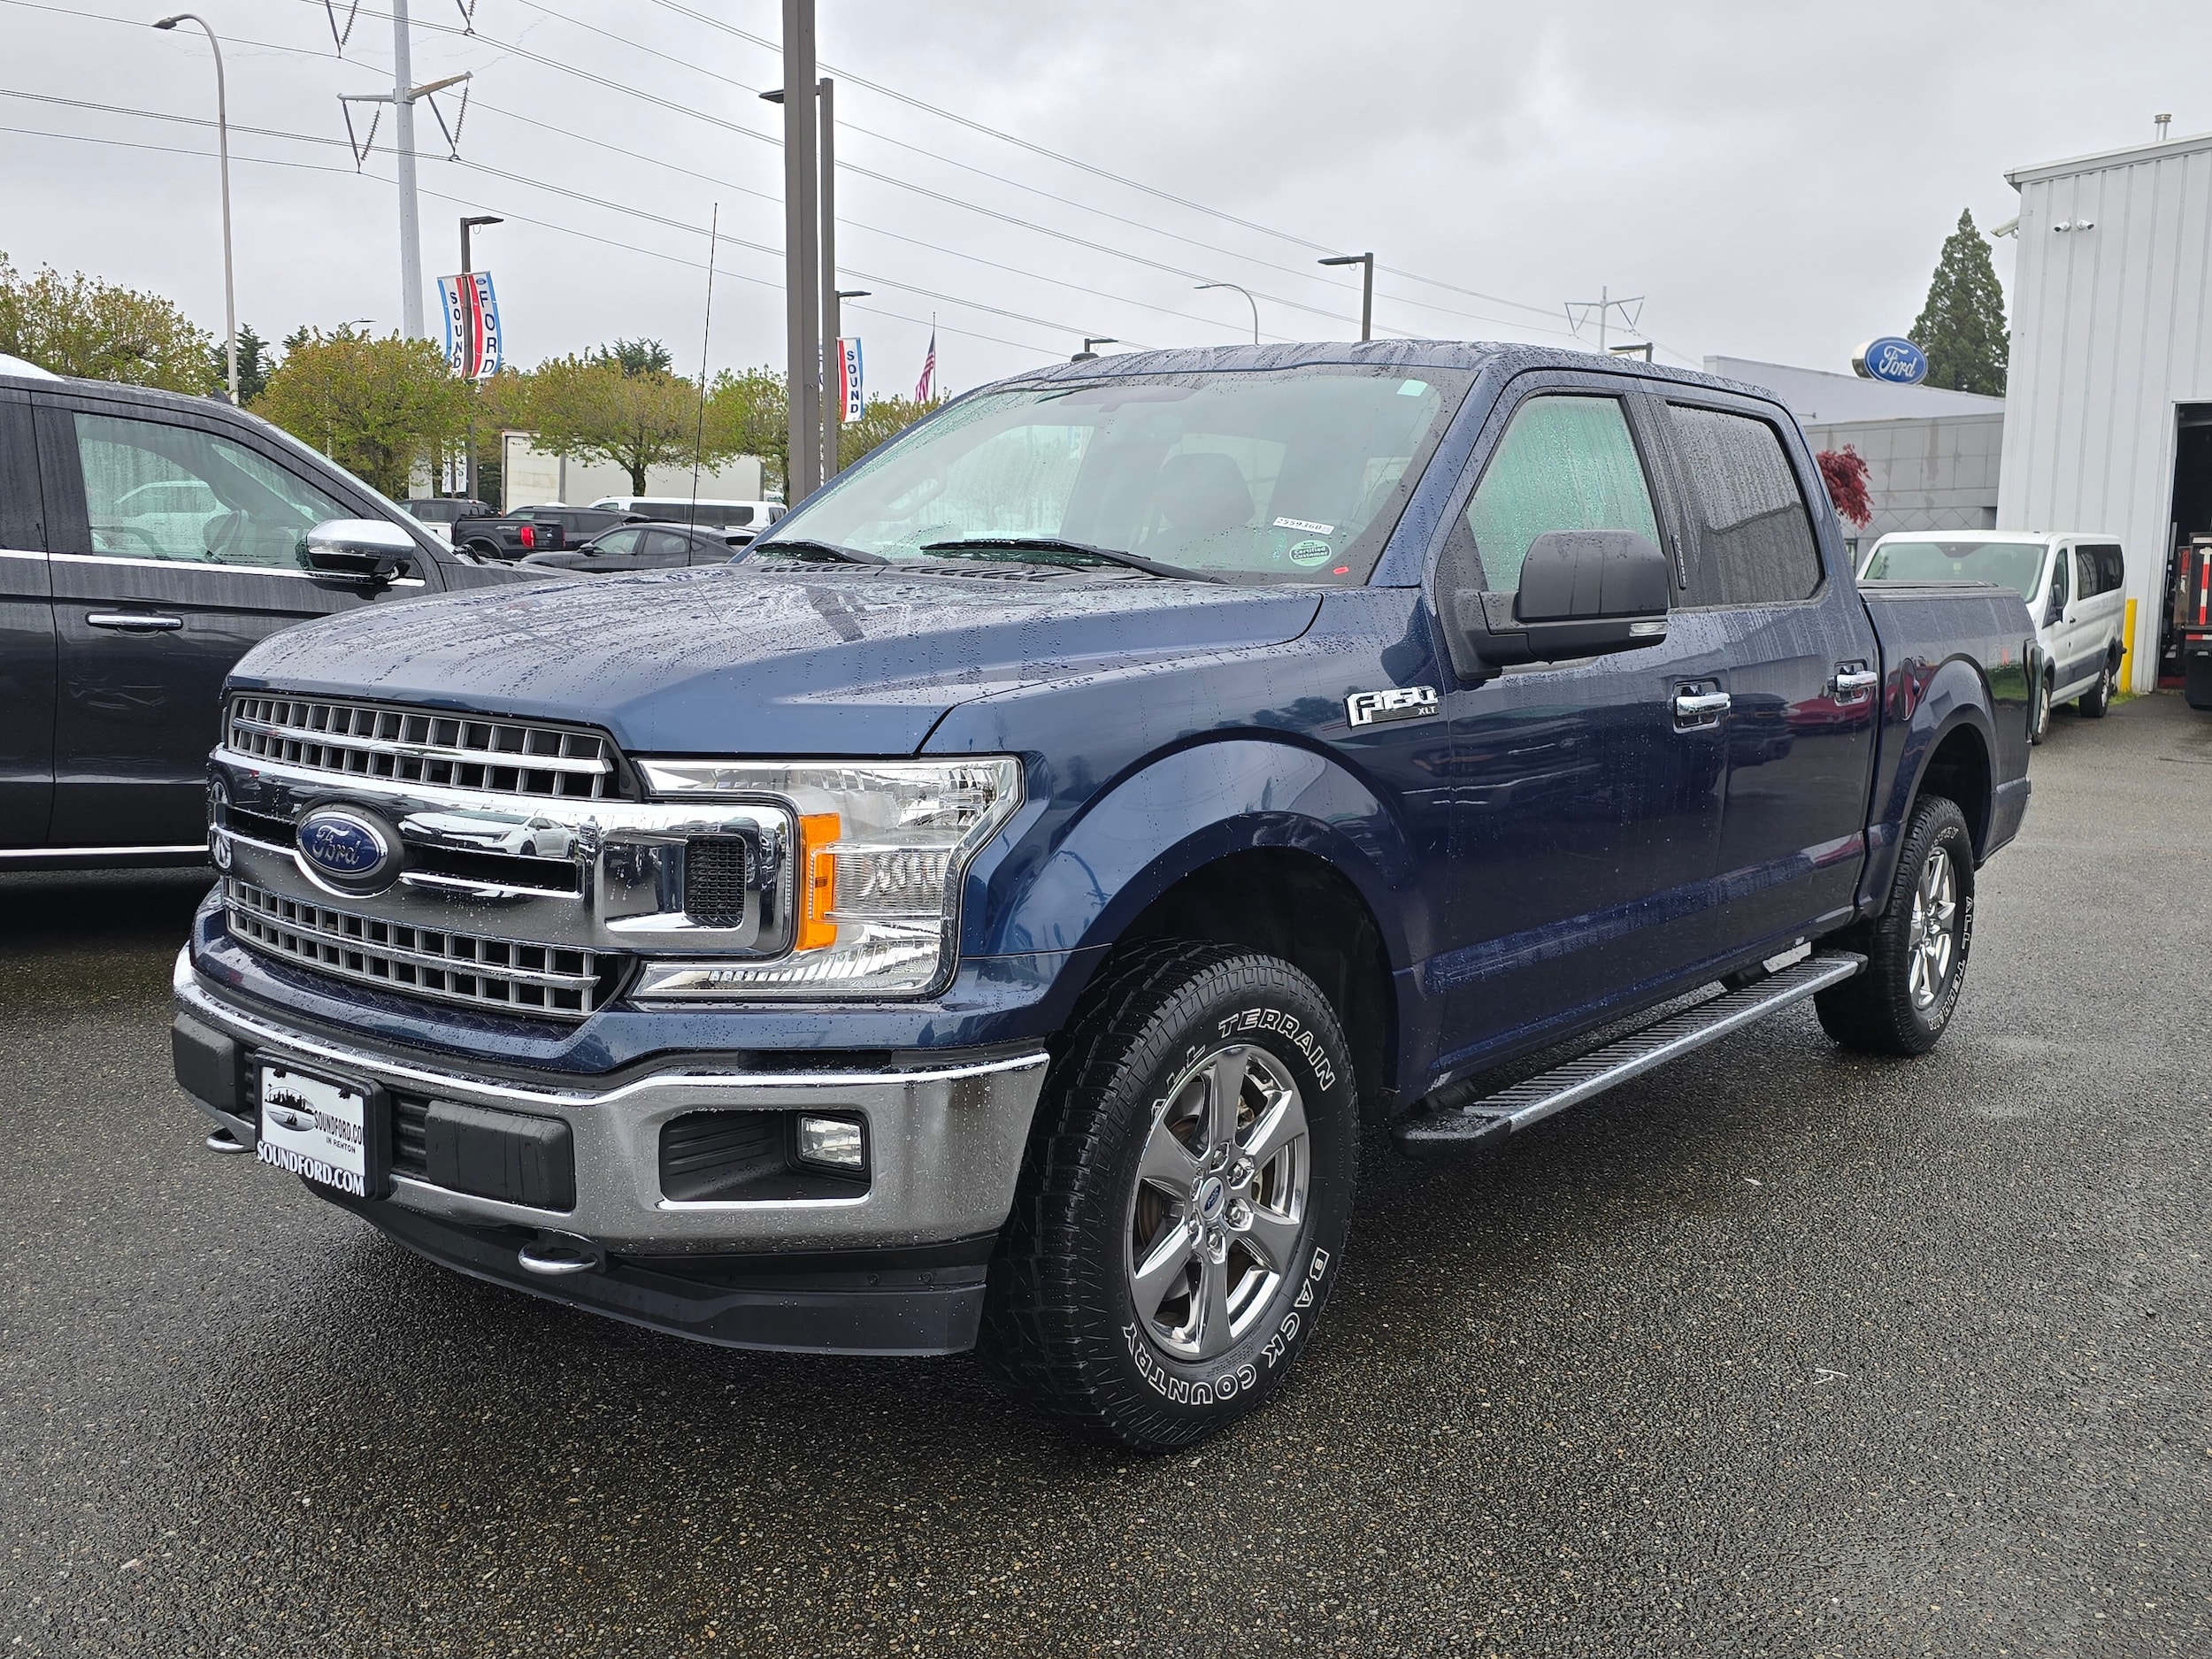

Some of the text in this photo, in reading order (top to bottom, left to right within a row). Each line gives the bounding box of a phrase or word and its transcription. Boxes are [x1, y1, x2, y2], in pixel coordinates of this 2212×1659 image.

[449, 291, 463, 369] SOUND
[479, 290, 497, 373] FORD
[847, 350, 859, 413] SOUND
[1878, 345, 1917, 378] Ford
[1294, 546, 1326, 555] Certified
[1417, 706, 1437, 716] XLT
[312, 825, 362, 865] Ford
[1217, 1008, 1336, 1092] TERRAIN
[314, 1110, 364, 1146] SOUNDFORD.CO
[257, 1140, 365, 1198] SOUNDFORD.COM
[1121, 1246, 1331, 1406] BACK COUNTRY
